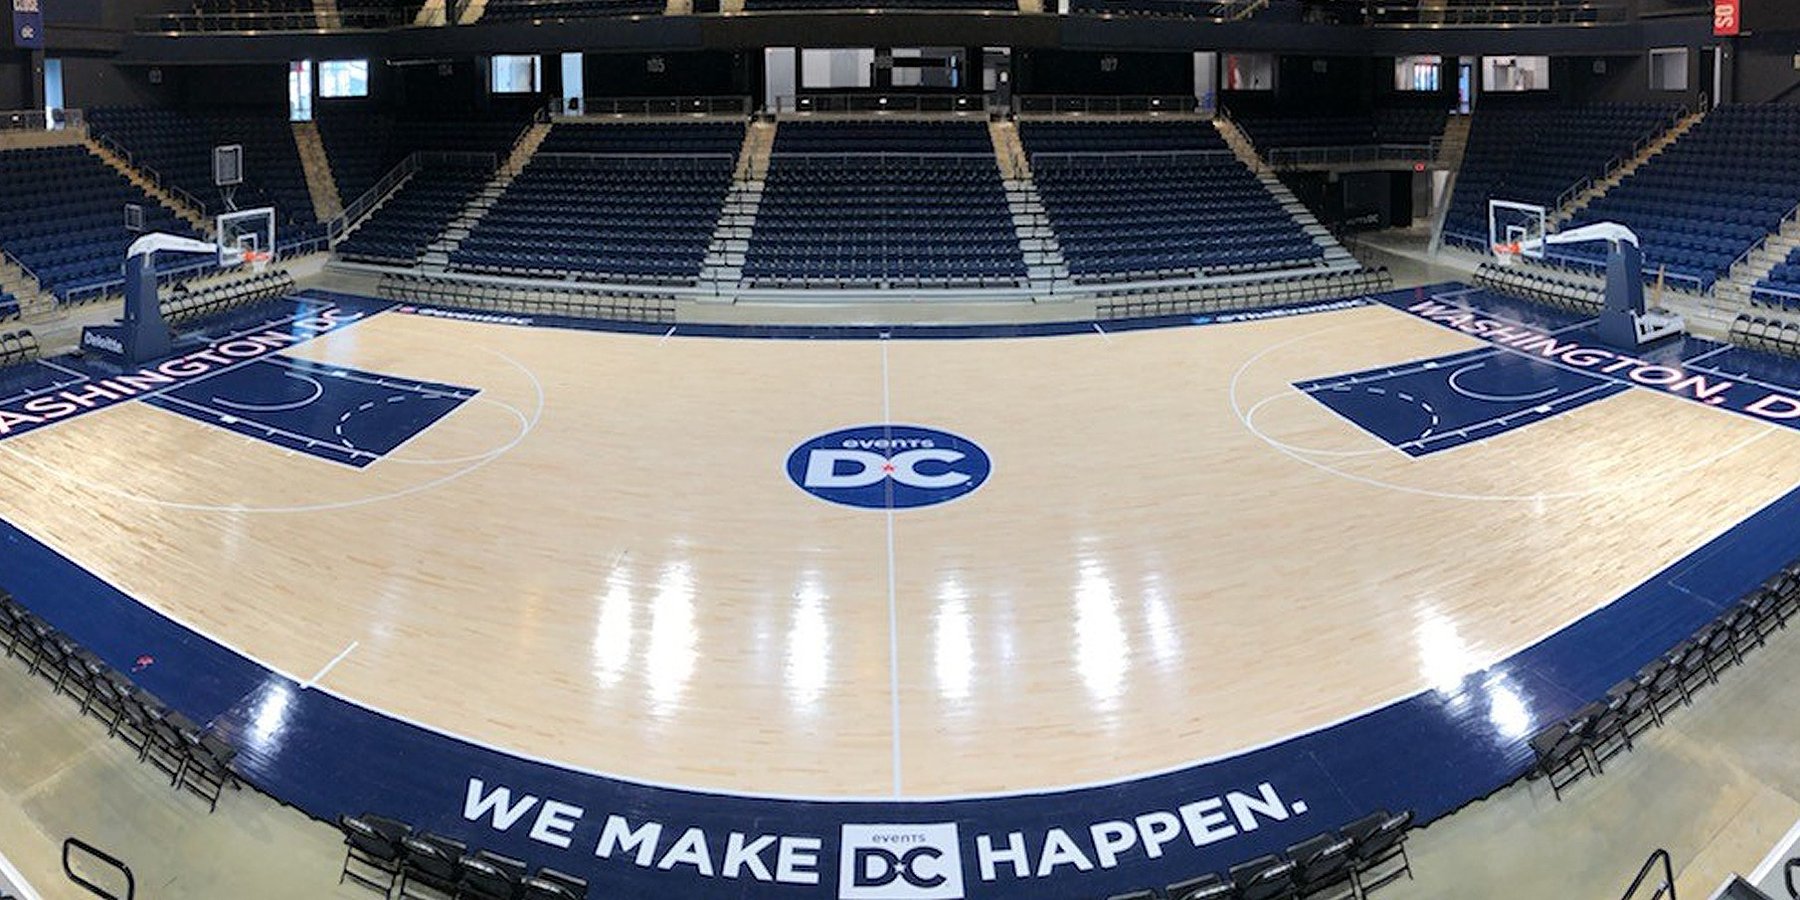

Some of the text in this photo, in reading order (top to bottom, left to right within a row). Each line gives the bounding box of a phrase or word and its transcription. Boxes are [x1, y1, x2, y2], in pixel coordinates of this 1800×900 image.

[0, 330, 314, 435] ASHINGTON,
[1407, 300, 1800, 419] WASHINGTON, D
[804, 449, 972, 489] DC
[841, 438, 934, 448] events
[463, 777, 822, 885] WE MAKE
[871, 834, 926, 843] events
[977, 782, 1307, 880] HAPPEN.
[854, 846, 947, 888] DC
